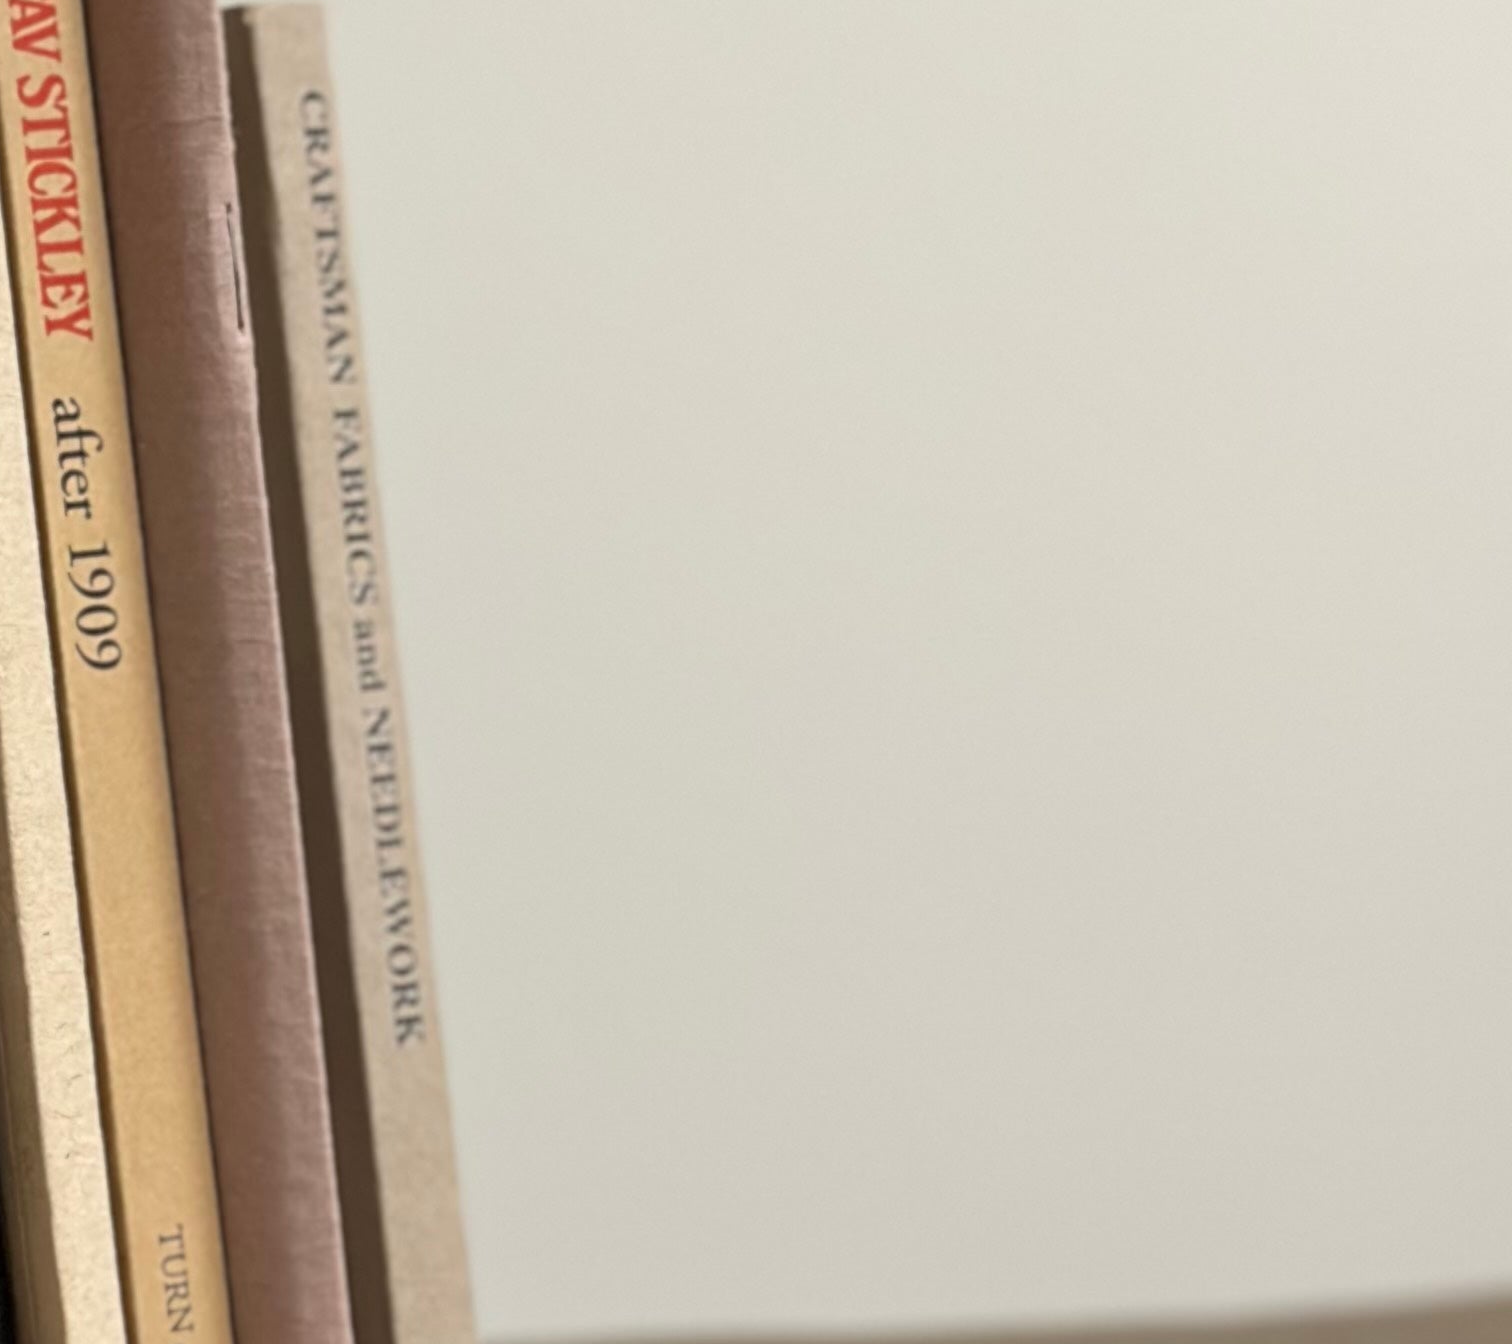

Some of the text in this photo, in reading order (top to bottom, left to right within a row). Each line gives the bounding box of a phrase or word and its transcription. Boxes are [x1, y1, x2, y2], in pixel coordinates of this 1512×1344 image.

[17, 74, 93, 341] STICKLEY
[52, 397, 103, 518] after
[68, 542, 122, 670] 1909
[301, 89, 424, 1046] CRAFTSMAN FABRICS and NEEDLEWORK
[159, 1224, 194, 1334] TURN
